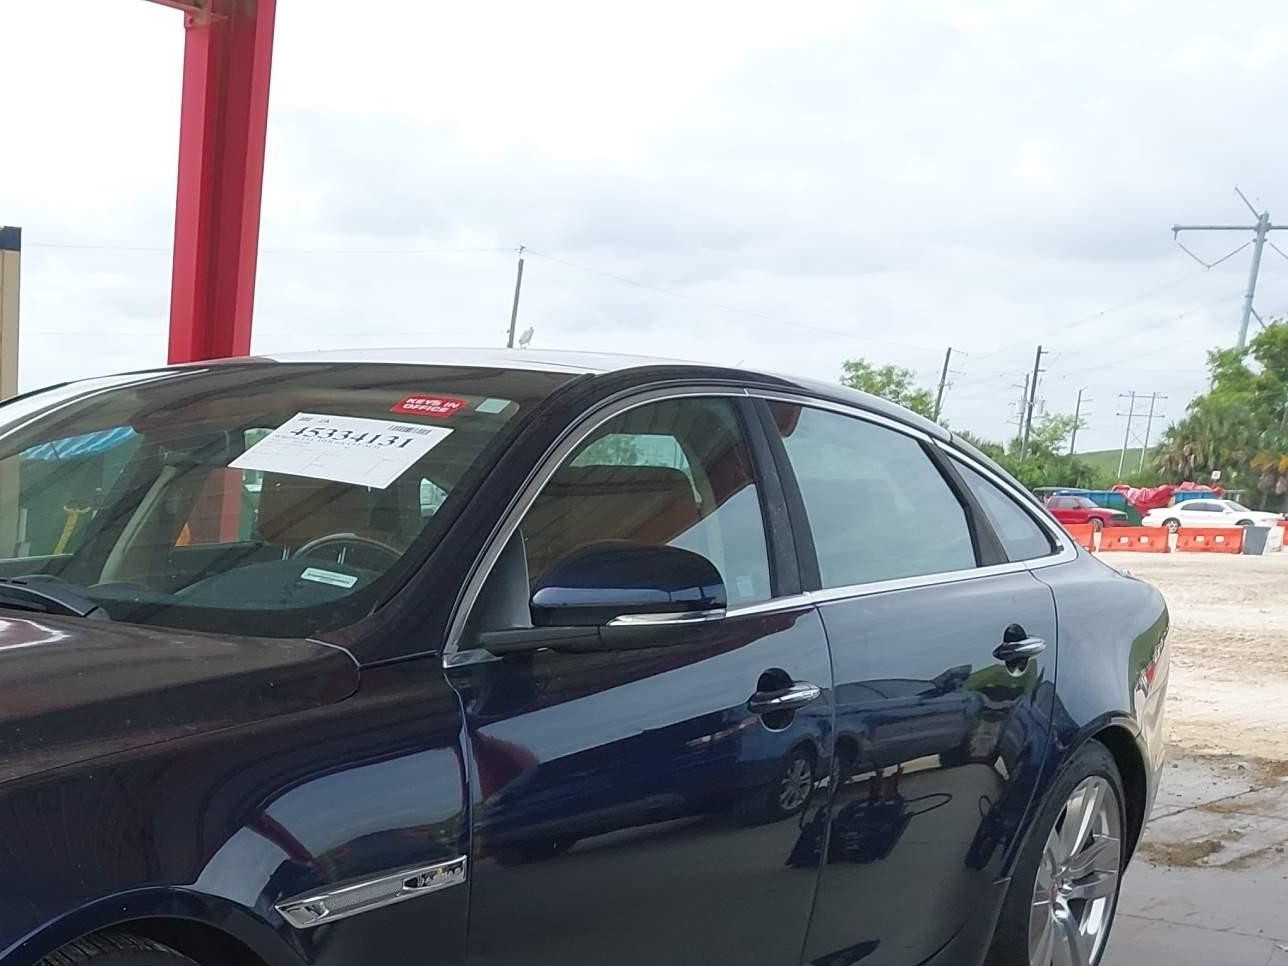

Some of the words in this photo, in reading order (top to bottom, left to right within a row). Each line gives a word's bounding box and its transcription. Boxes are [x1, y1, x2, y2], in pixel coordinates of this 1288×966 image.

[406, 398, 442, 406] KEYS
[402, 403, 450, 412] OFFICE
[290, 426, 414, 449] 45334131
